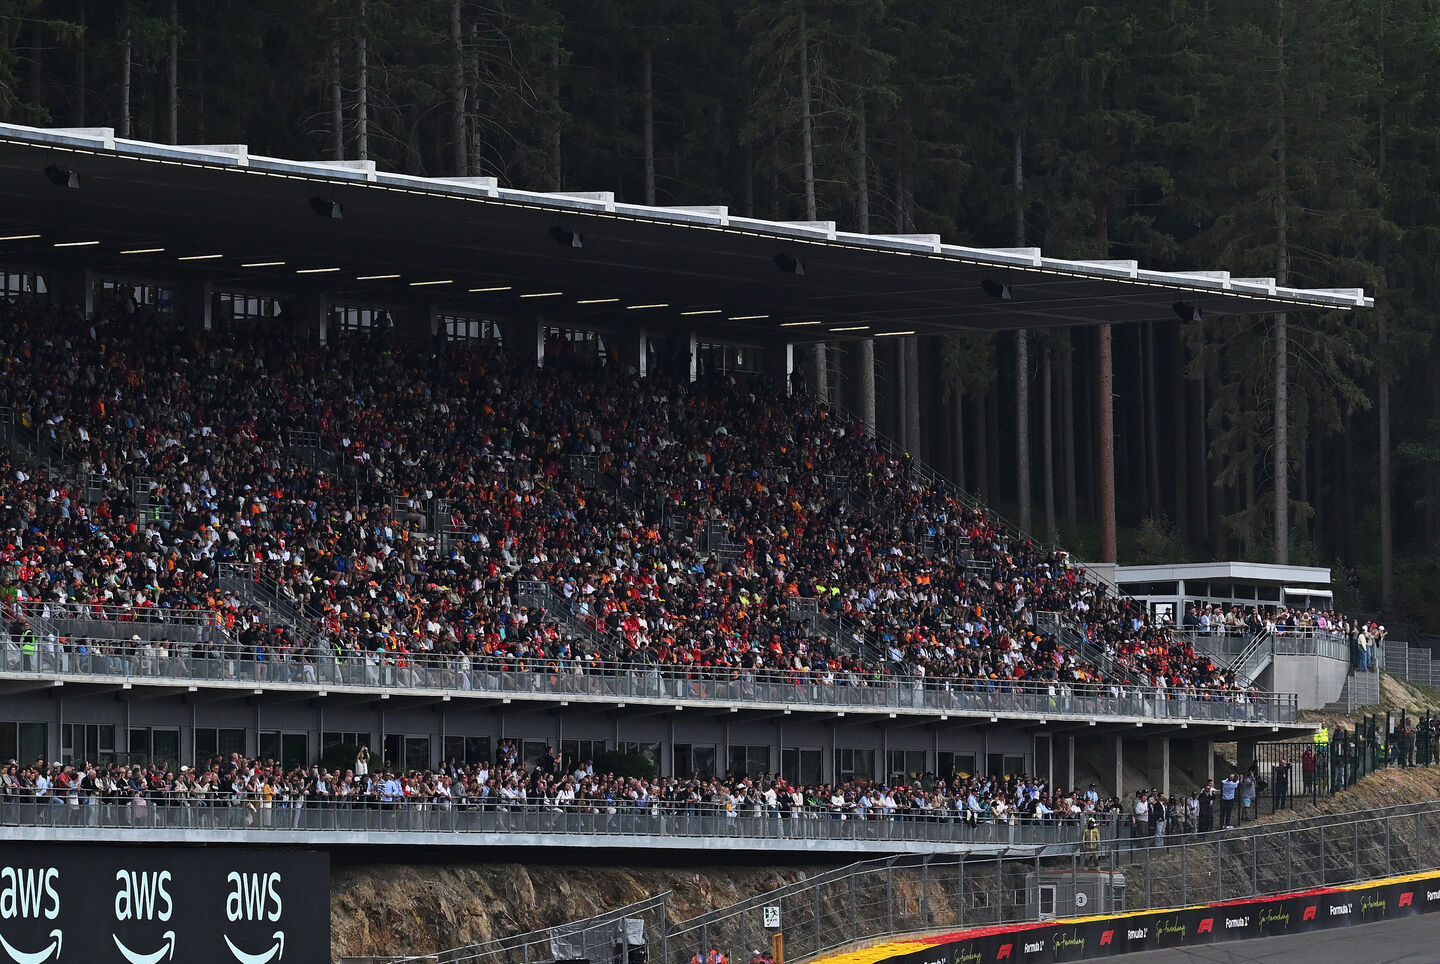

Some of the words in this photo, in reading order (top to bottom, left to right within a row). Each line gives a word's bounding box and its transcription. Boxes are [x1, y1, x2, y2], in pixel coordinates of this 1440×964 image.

[1, 866, 60, 920] aws
[115, 869, 173, 922] aws
[226, 871, 283, 922] aws
[1078, 896, 1084, 904] 3
[1225, 917, 1243, 929] Formula
